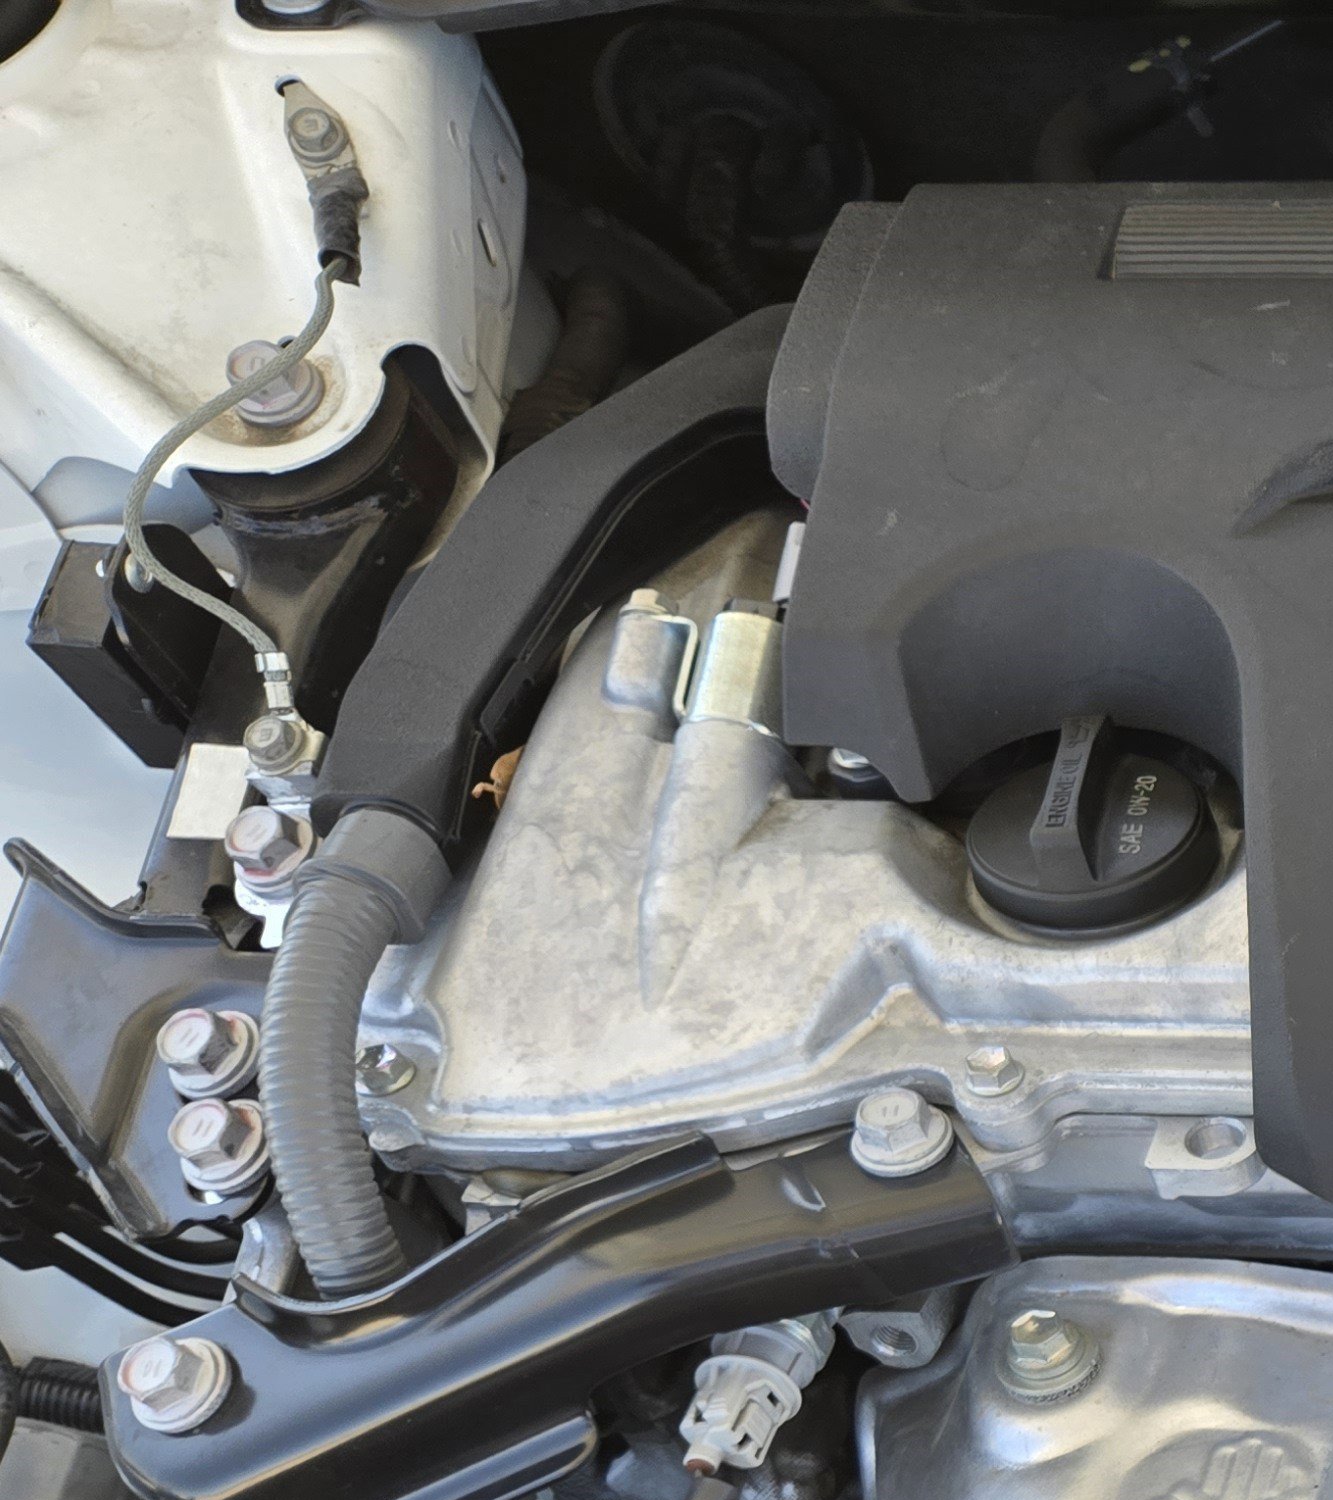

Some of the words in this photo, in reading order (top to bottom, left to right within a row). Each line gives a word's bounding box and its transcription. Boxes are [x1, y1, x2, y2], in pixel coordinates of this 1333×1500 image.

[1046, 777, 1078, 828] ENGINE
[1130, 774, 1158, 817] 0W-20
[1118, 823, 1143, 855] SAE
